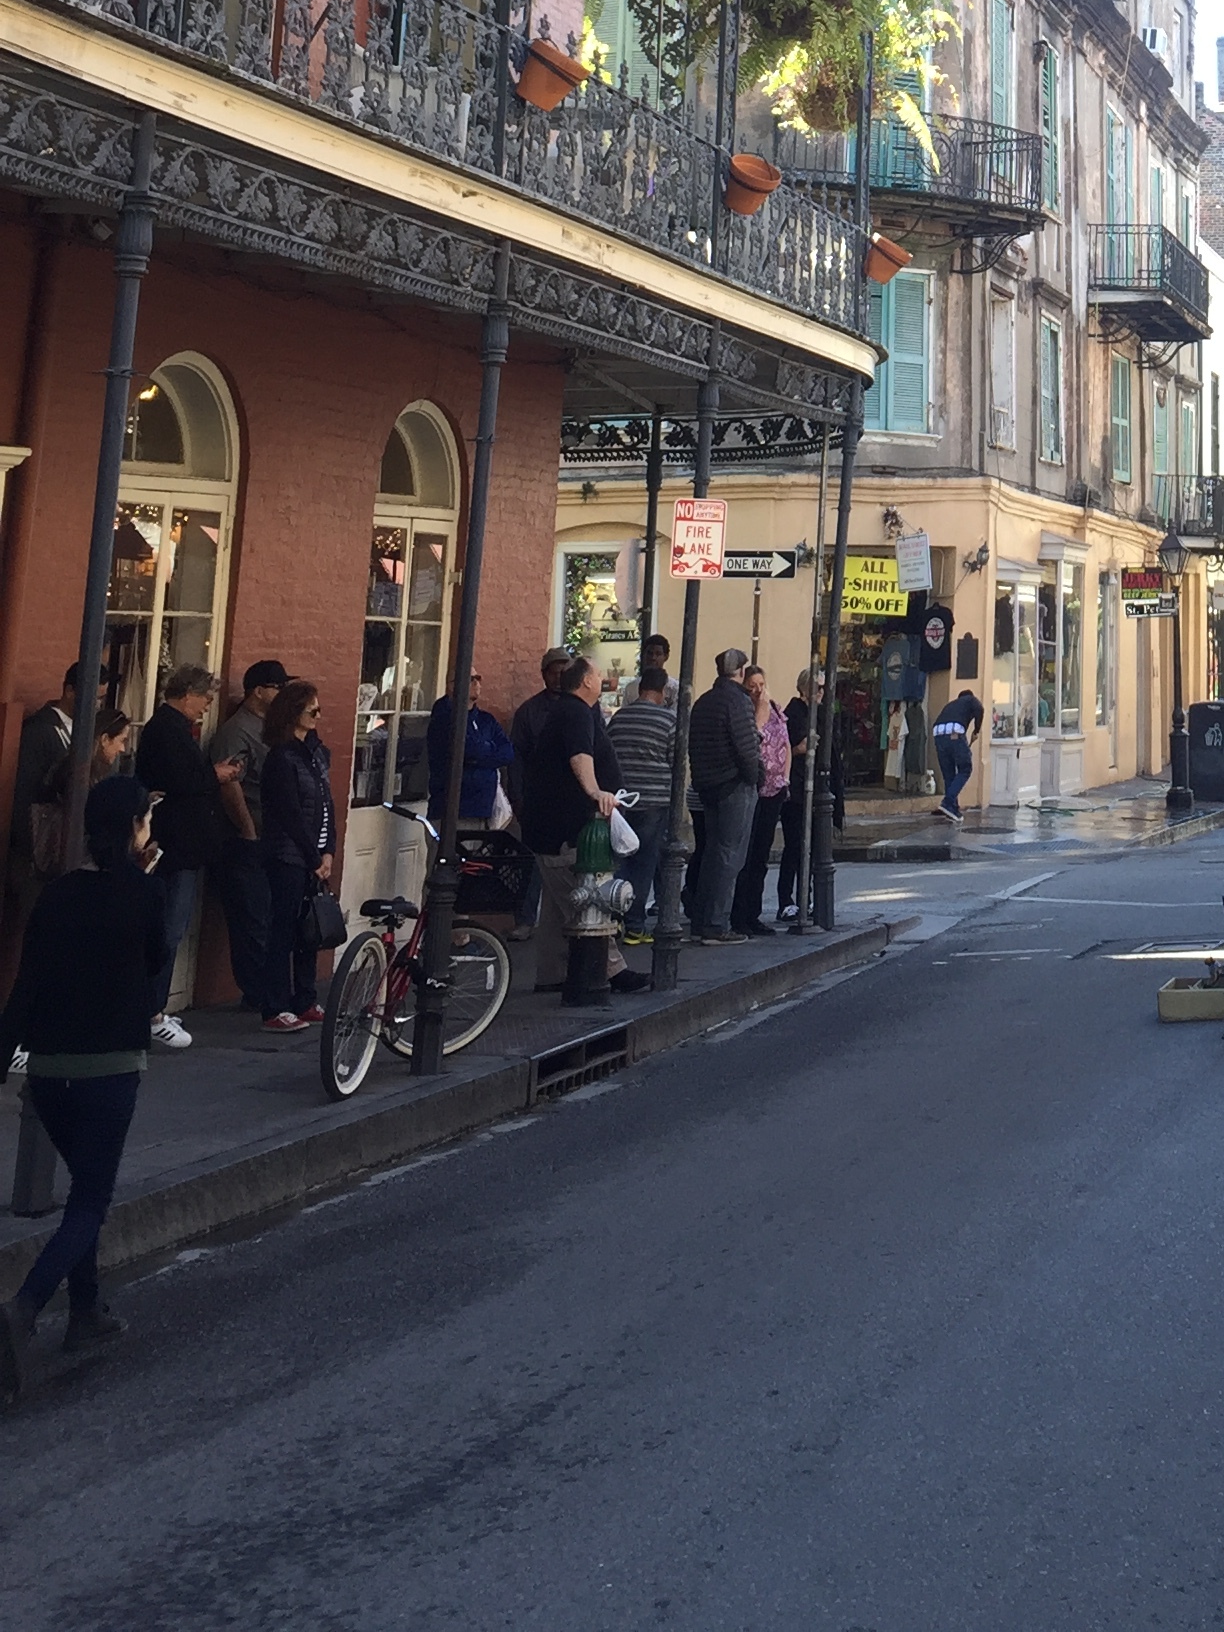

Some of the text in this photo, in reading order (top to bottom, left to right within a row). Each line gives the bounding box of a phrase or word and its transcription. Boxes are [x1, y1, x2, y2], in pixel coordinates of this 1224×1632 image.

[676, 502, 694, 518] NO
[685, 525, 712, 539] FIRE
[683, 542, 713, 556] LANE
[726, 558, 773, 570] ONE WAY
[860, 560, 888, 575] ALL
[841, 596, 904, 613] 50% OFF
